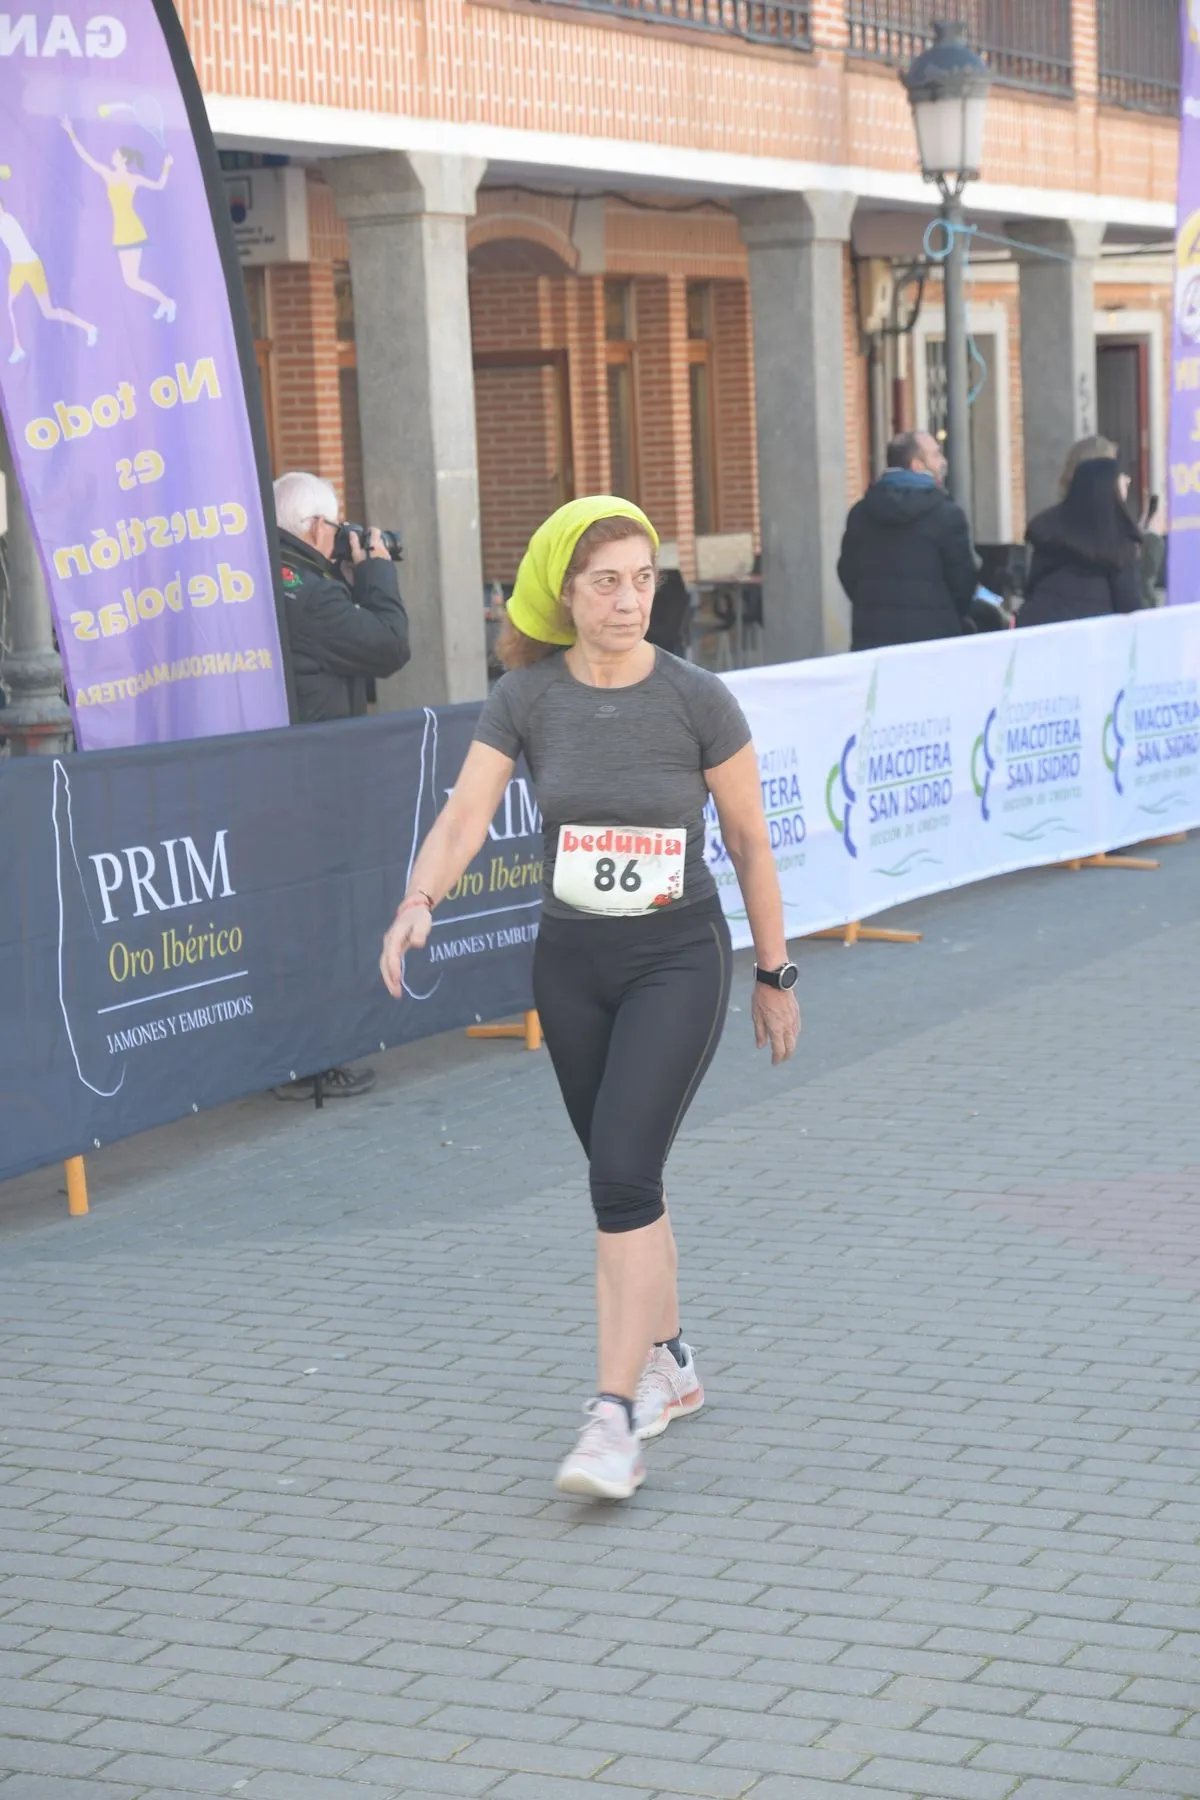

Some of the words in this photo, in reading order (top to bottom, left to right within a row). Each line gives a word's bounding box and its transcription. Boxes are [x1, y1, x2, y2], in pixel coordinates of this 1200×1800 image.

[1006, 717, 1082, 754] MACOTERA
[868, 741, 953, 785] MACOTERA
[1006, 761, 1033, 791] SAN
[1037, 752, 1081, 784] ISIDRO
[868, 791, 900, 824] SAN
[903, 778, 953, 815] ISIDRO
[562, 830, 681, 855] bedunia
[769, 813, 806, 850] DRO
[88, 829, 236, 924] PRIM
[594, 857, 642, 892] 86
[108, 941, 154, 982] Oro
[161, 922, 243, 971] Ibérico
[430, 933, 485, 963] JAMONES
[485, 932, 495, 951] Y
[106, 1019, 168, 1055] JAMONES
[167, 1018, 178, 1036] Y
[178, 995, 254, 1033] EMBUTIDOS
